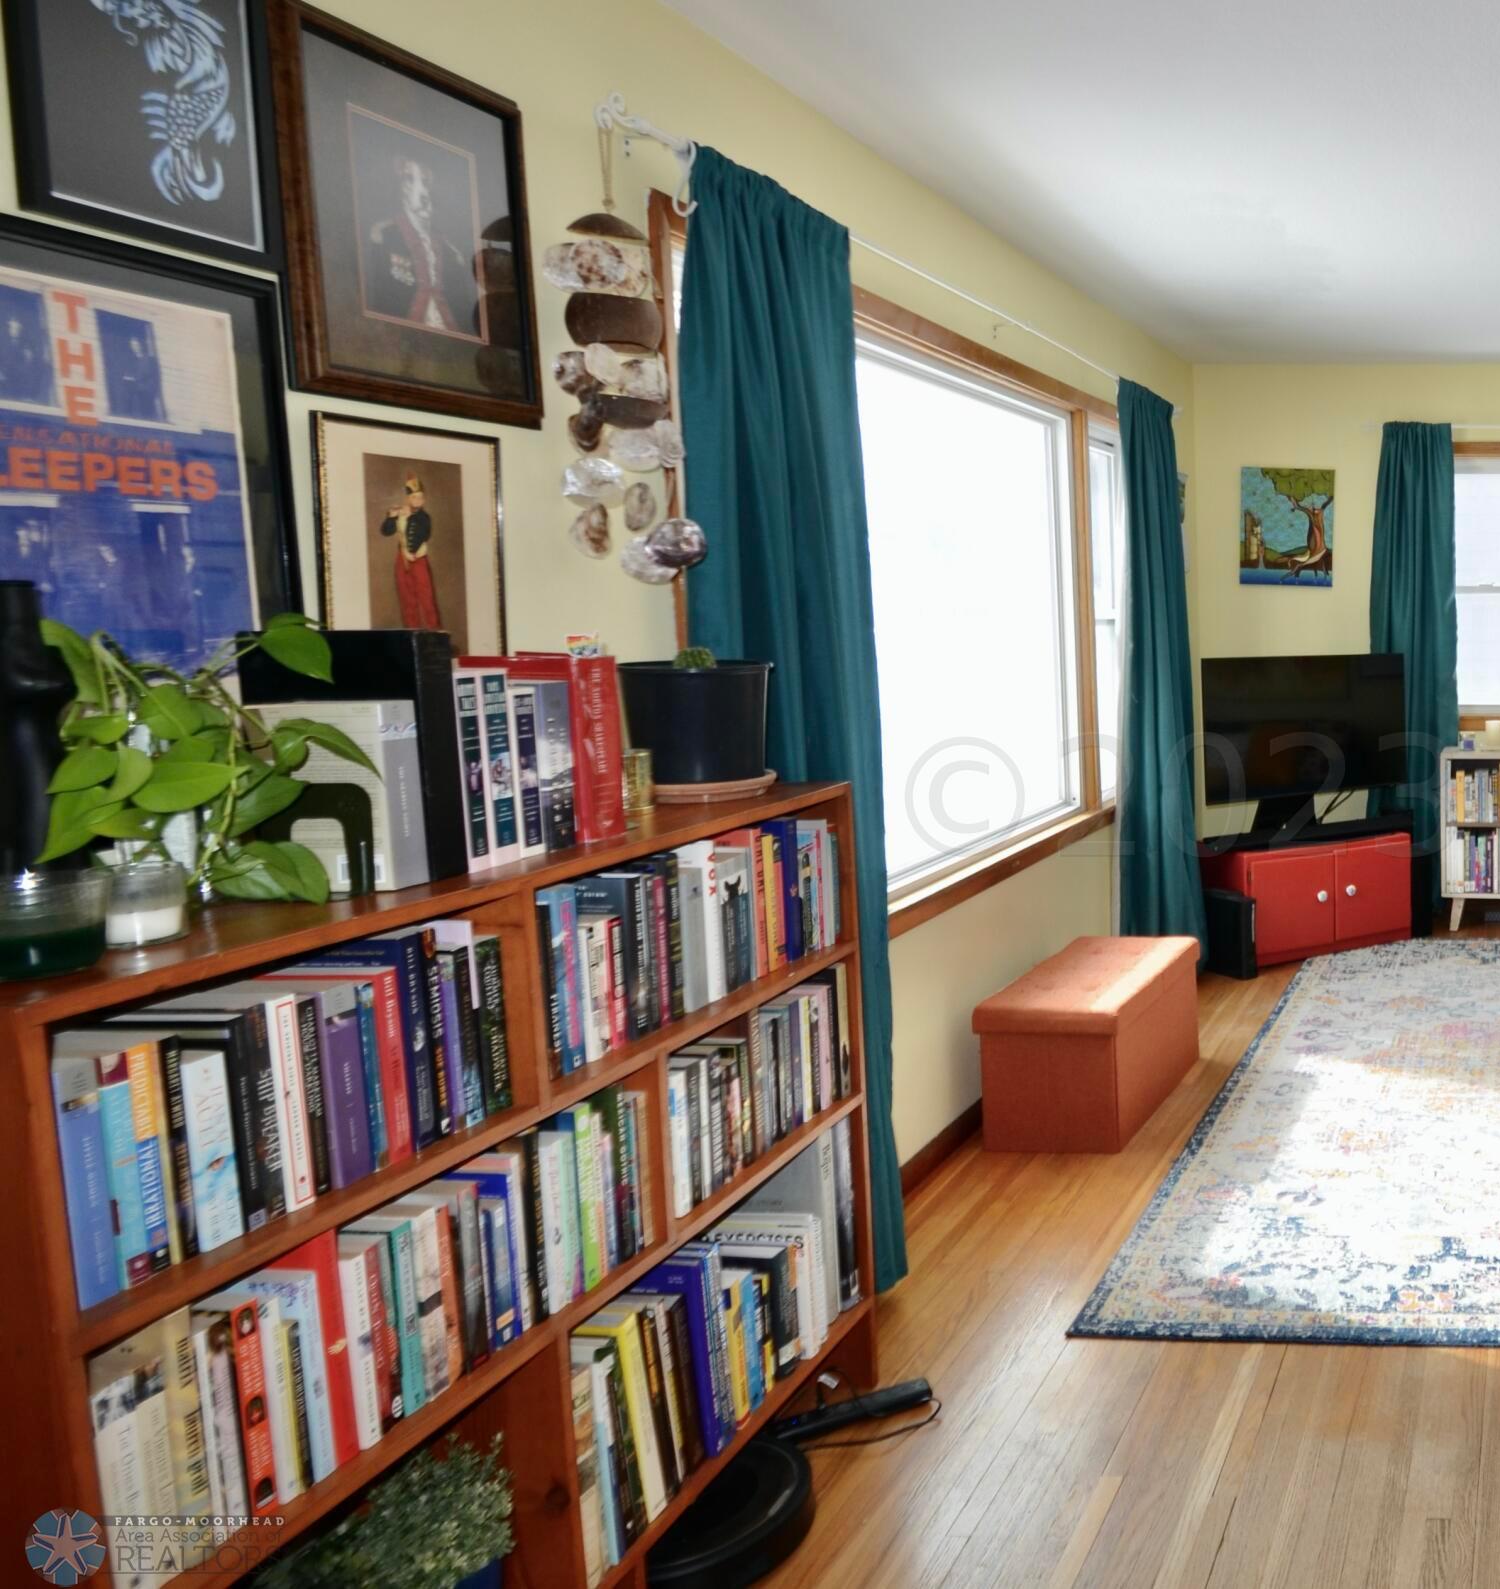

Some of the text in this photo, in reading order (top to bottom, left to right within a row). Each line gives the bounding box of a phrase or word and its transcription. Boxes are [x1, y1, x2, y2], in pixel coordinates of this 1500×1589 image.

[53, 290, 99, 426] THE
[0, 445, 218, 501] EEPERS
[706, 852, 717, 896] VOX
[427, 966, 443, 1039] SEMIOSIS
[436, 1046, 444, 1067] SUE
[549, 993, 563, 1053] PIRANESI
[130, 1053, 157, 1140] PREDICTABLY
[255, 1068, 275, 1102] SHIP
[260, 1106, 283, 1173] BREAKER
[616, 1093, 628, 1185] MEXICAN GOTHIC
[137, 1146, 166, 1229] IRRATIONAL
[176, 1337, 198, 1389] matrix
